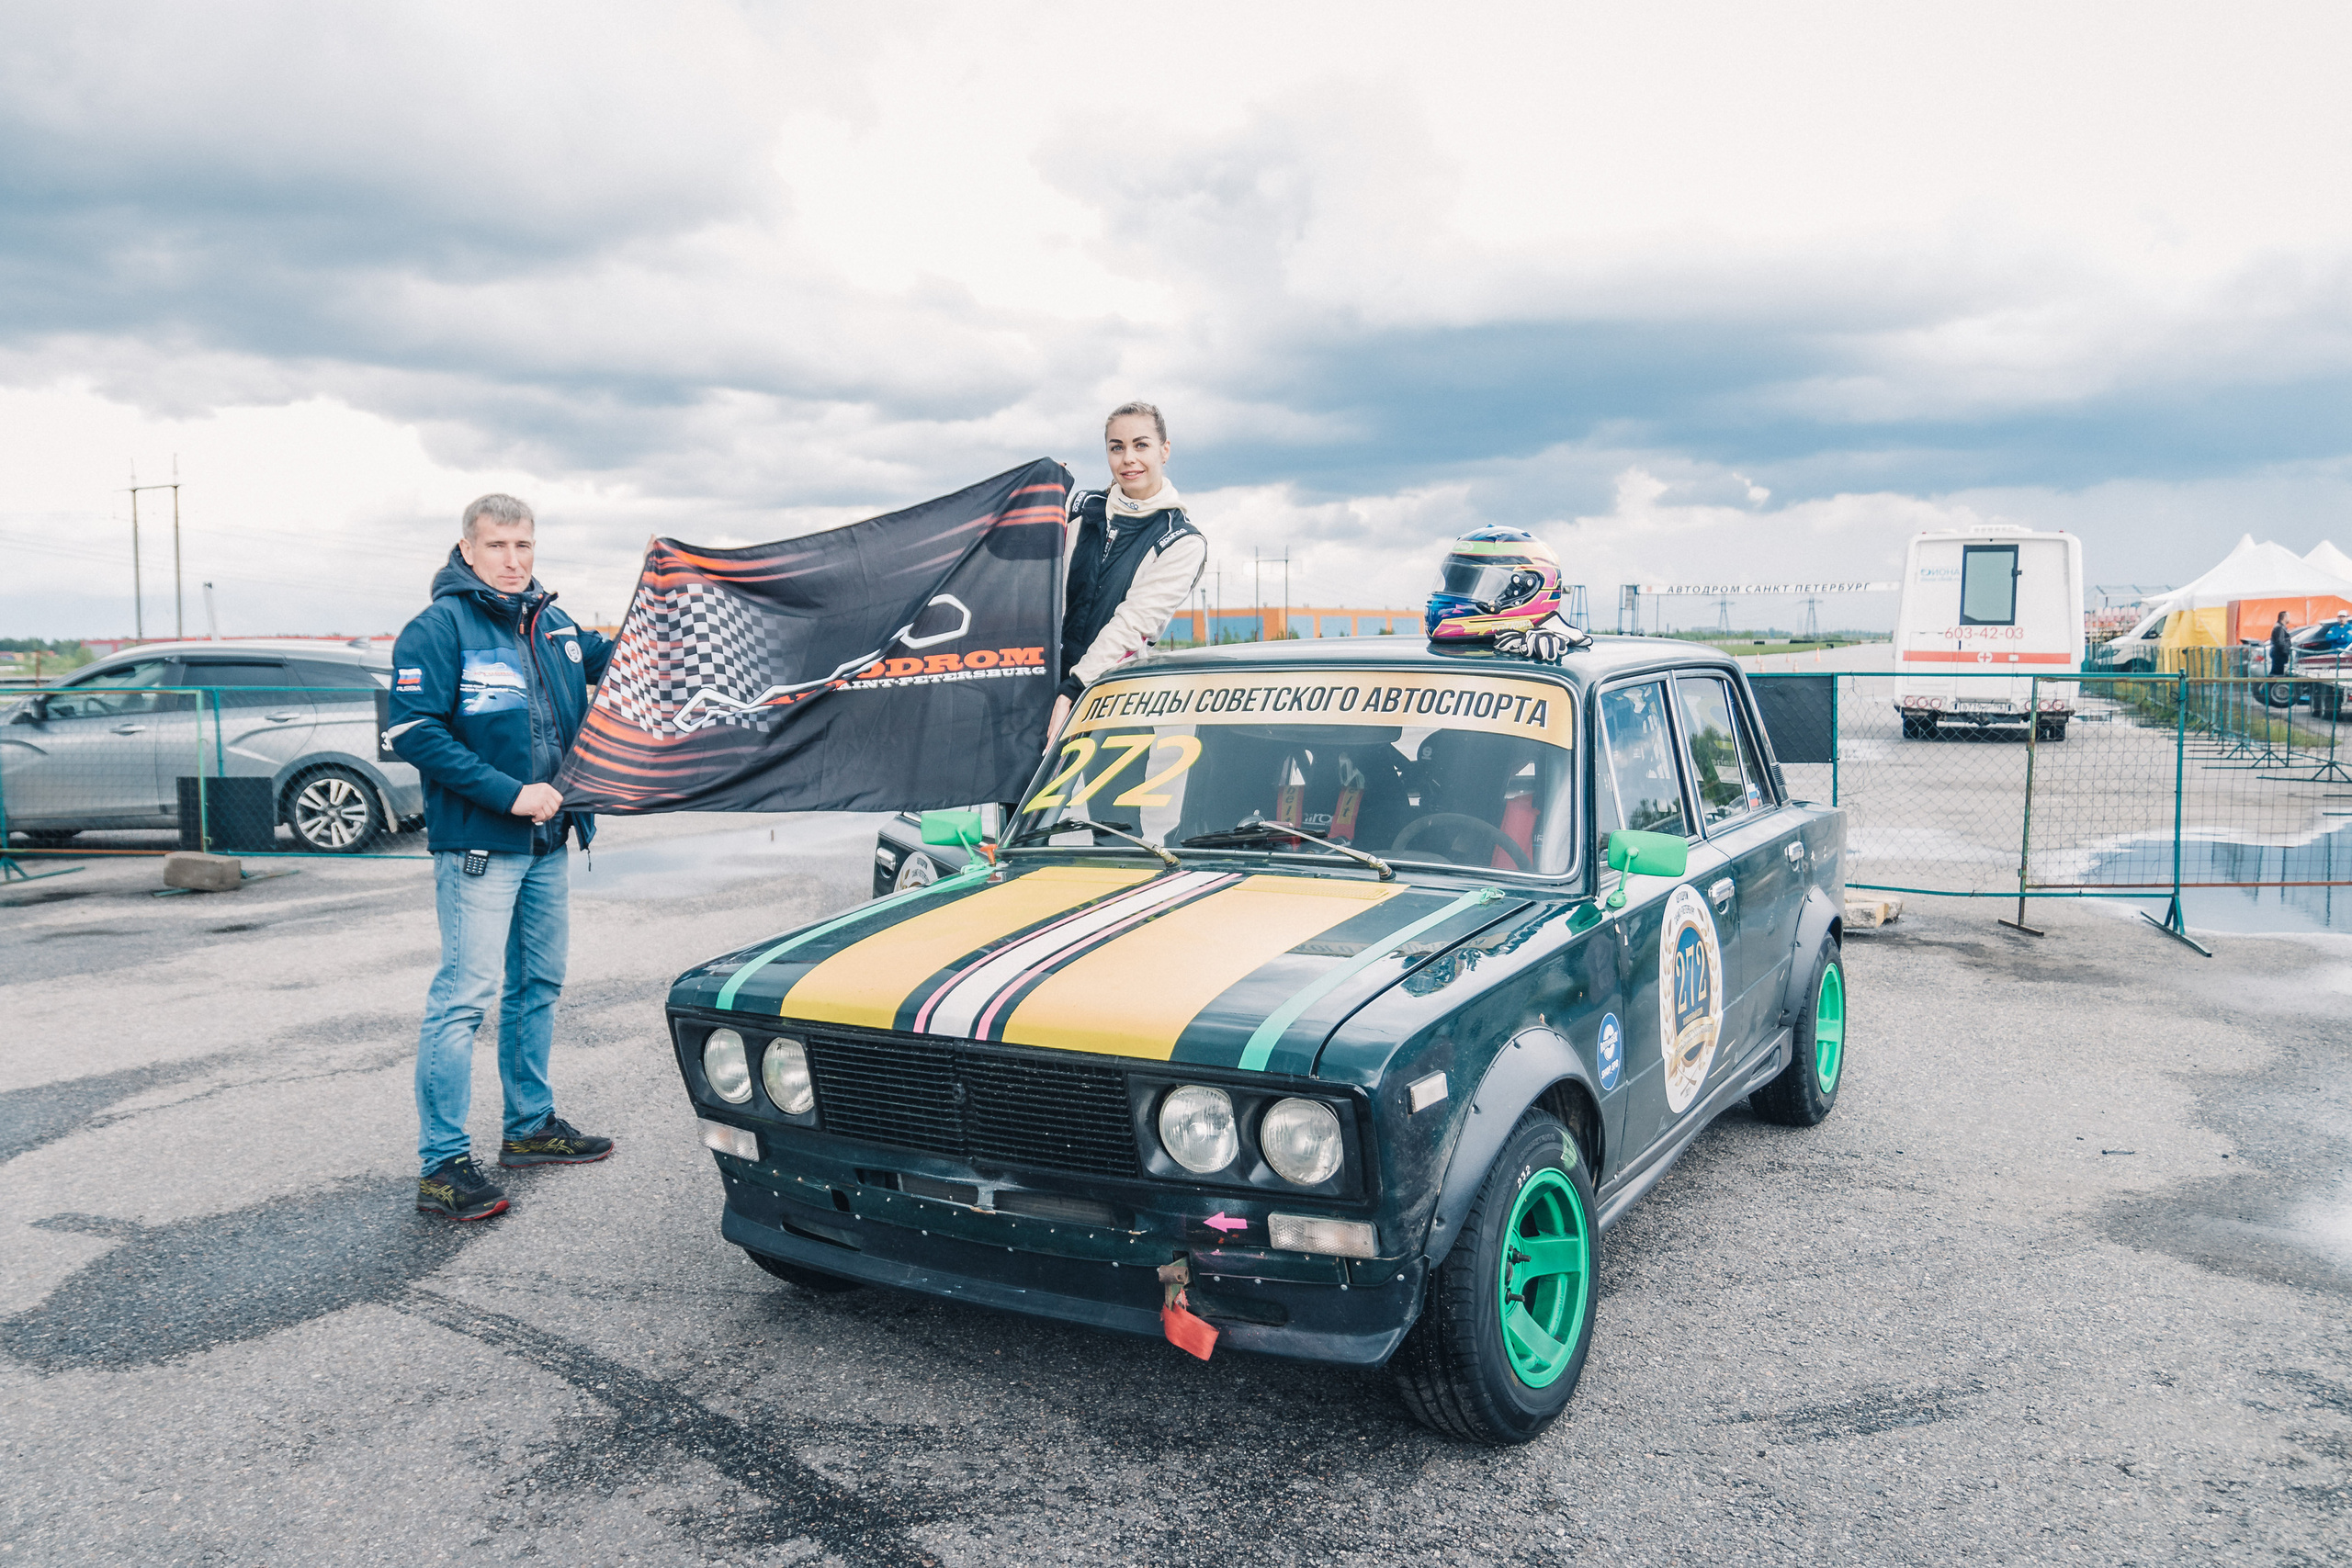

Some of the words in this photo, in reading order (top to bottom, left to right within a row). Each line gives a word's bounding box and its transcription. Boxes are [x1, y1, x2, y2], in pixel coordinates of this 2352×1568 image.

[1667, 585, 1741, 594] АВТОДРОМ
[1745, 584, 1790, 593] САНКТ
[1794, 582, 1871, 593] ПЕТЕРБУРГ
[1944, 626, 2024, 639] 603-42-03
[833, 666, 1047, 692] AINT-PETERSBURG
[1080, 689, 1195, 724] ЛЕГЕНДЫ
[1193, 685, 1361, 713] СОВЕТСКОГО
[1361, 685, 1549, 728] АВТОСПОРТА
[1022, 734, 1203, 815] 272
[1675, 940, 1707, 1015] 272
